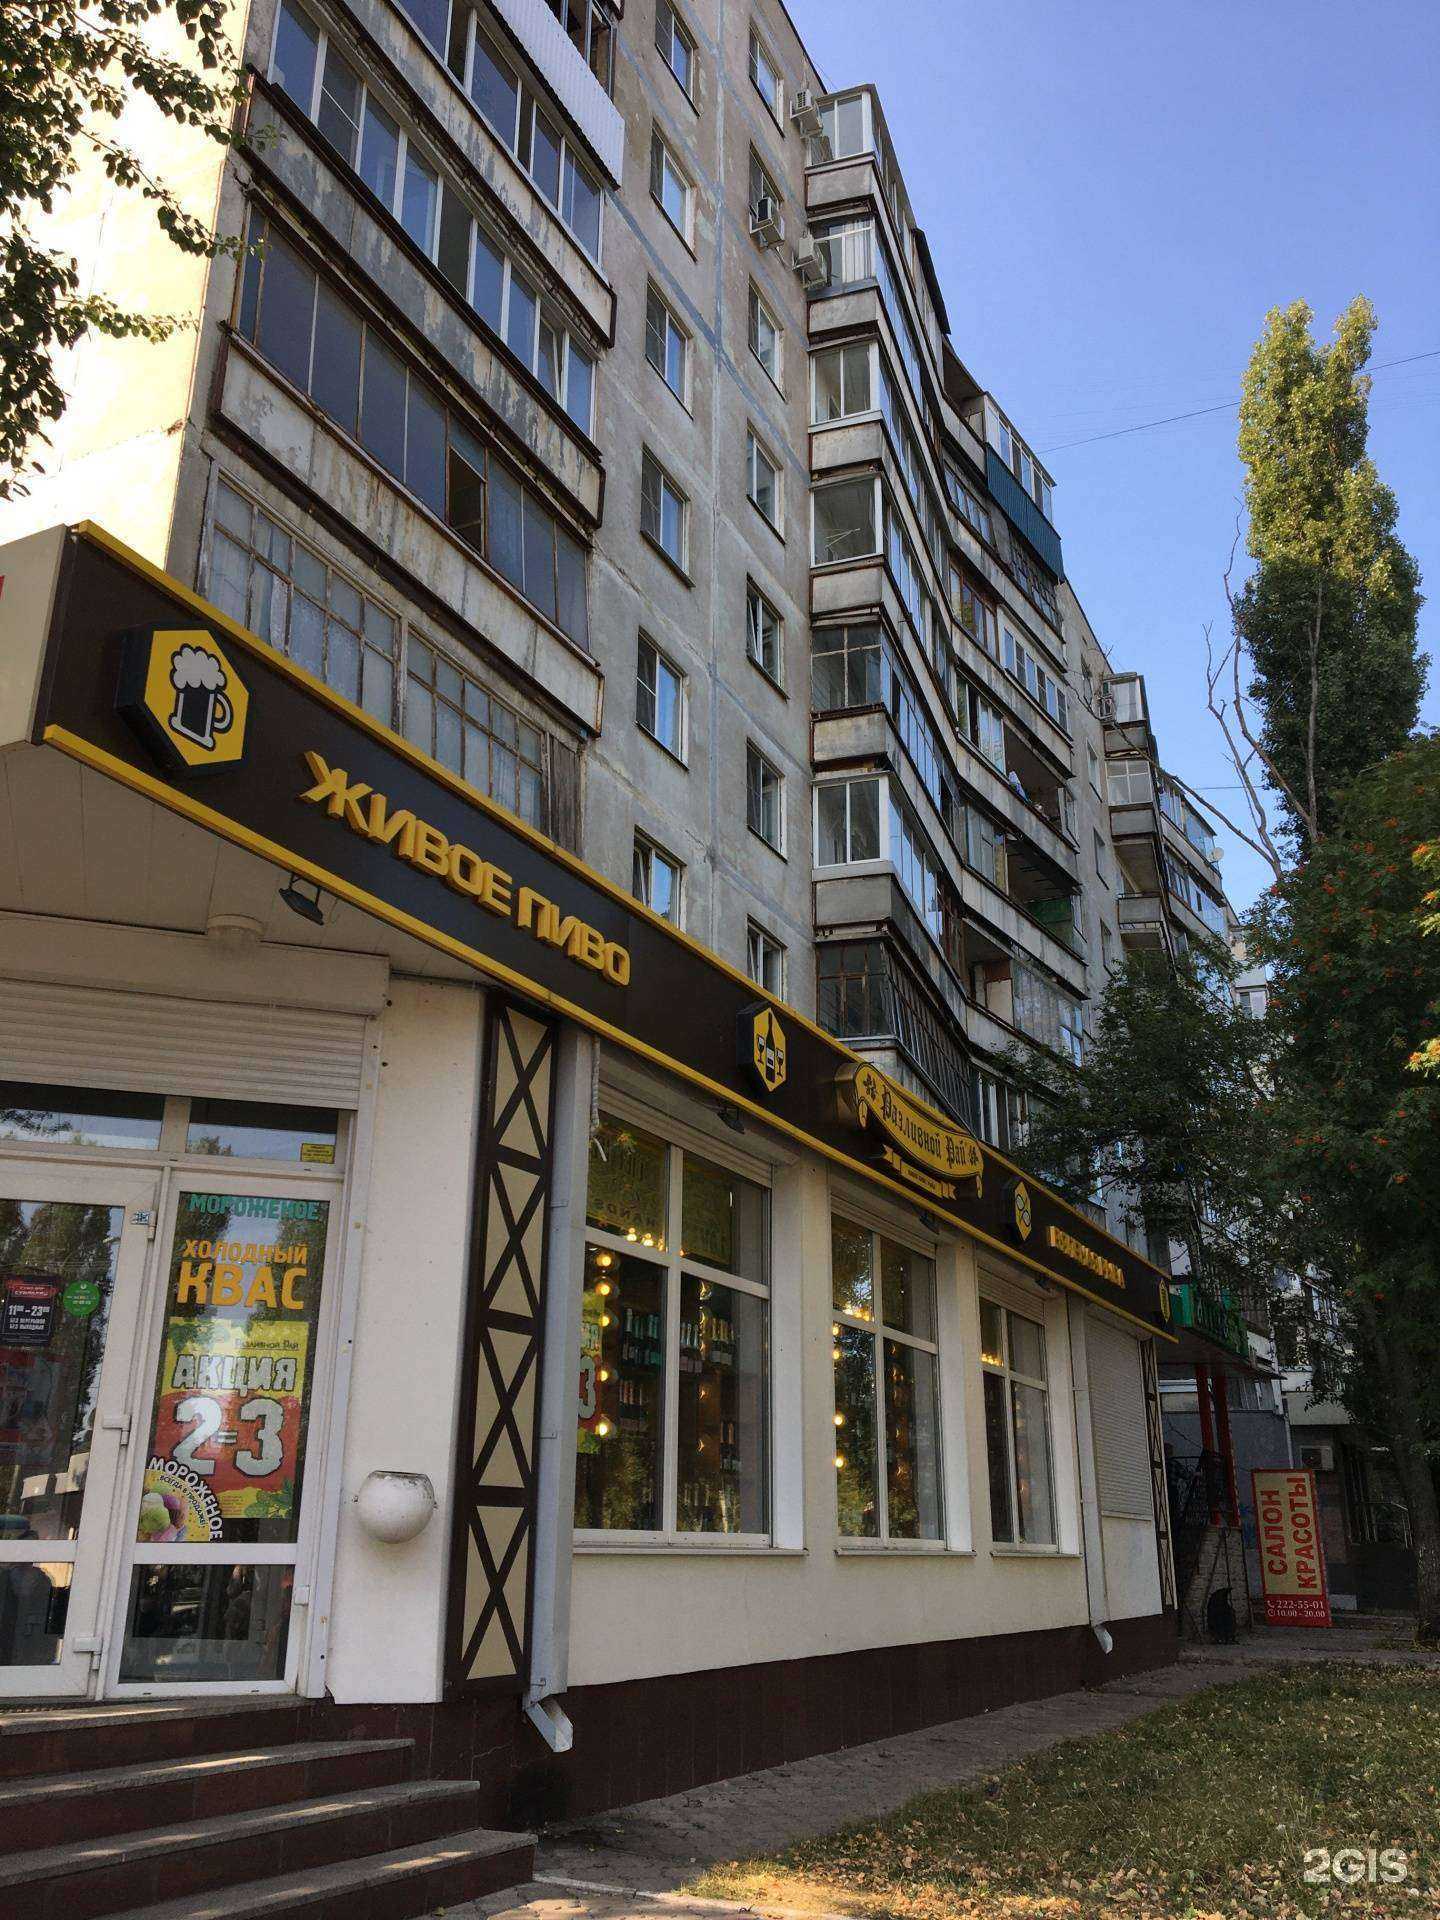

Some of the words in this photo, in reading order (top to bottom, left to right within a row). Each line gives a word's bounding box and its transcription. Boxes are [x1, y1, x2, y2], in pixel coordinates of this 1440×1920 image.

[299, 750, 513, 917] ЖИВОЕ
[517, 886, 631, 986] ПИВО
[881, 1086, 942, 1160] Разливной
[946, 1134, 967, 1169] Рай
[188, 1194, 320, 1219] МОРОЖЕНОЕ
[176, 1261, 309, 1310] КВАС
[182, 1239, 308, 1265] ХОЛОДНЫЙ
[172, 1353, 297, 1398] АКЦИЯ
[148, 1455, 223, 1543] МОРОЖЕНОЕ
[1260, 1490, 1288, 1575] САЛОН
[1287, 1477, 1317, 1589] КРАСОТЫ
